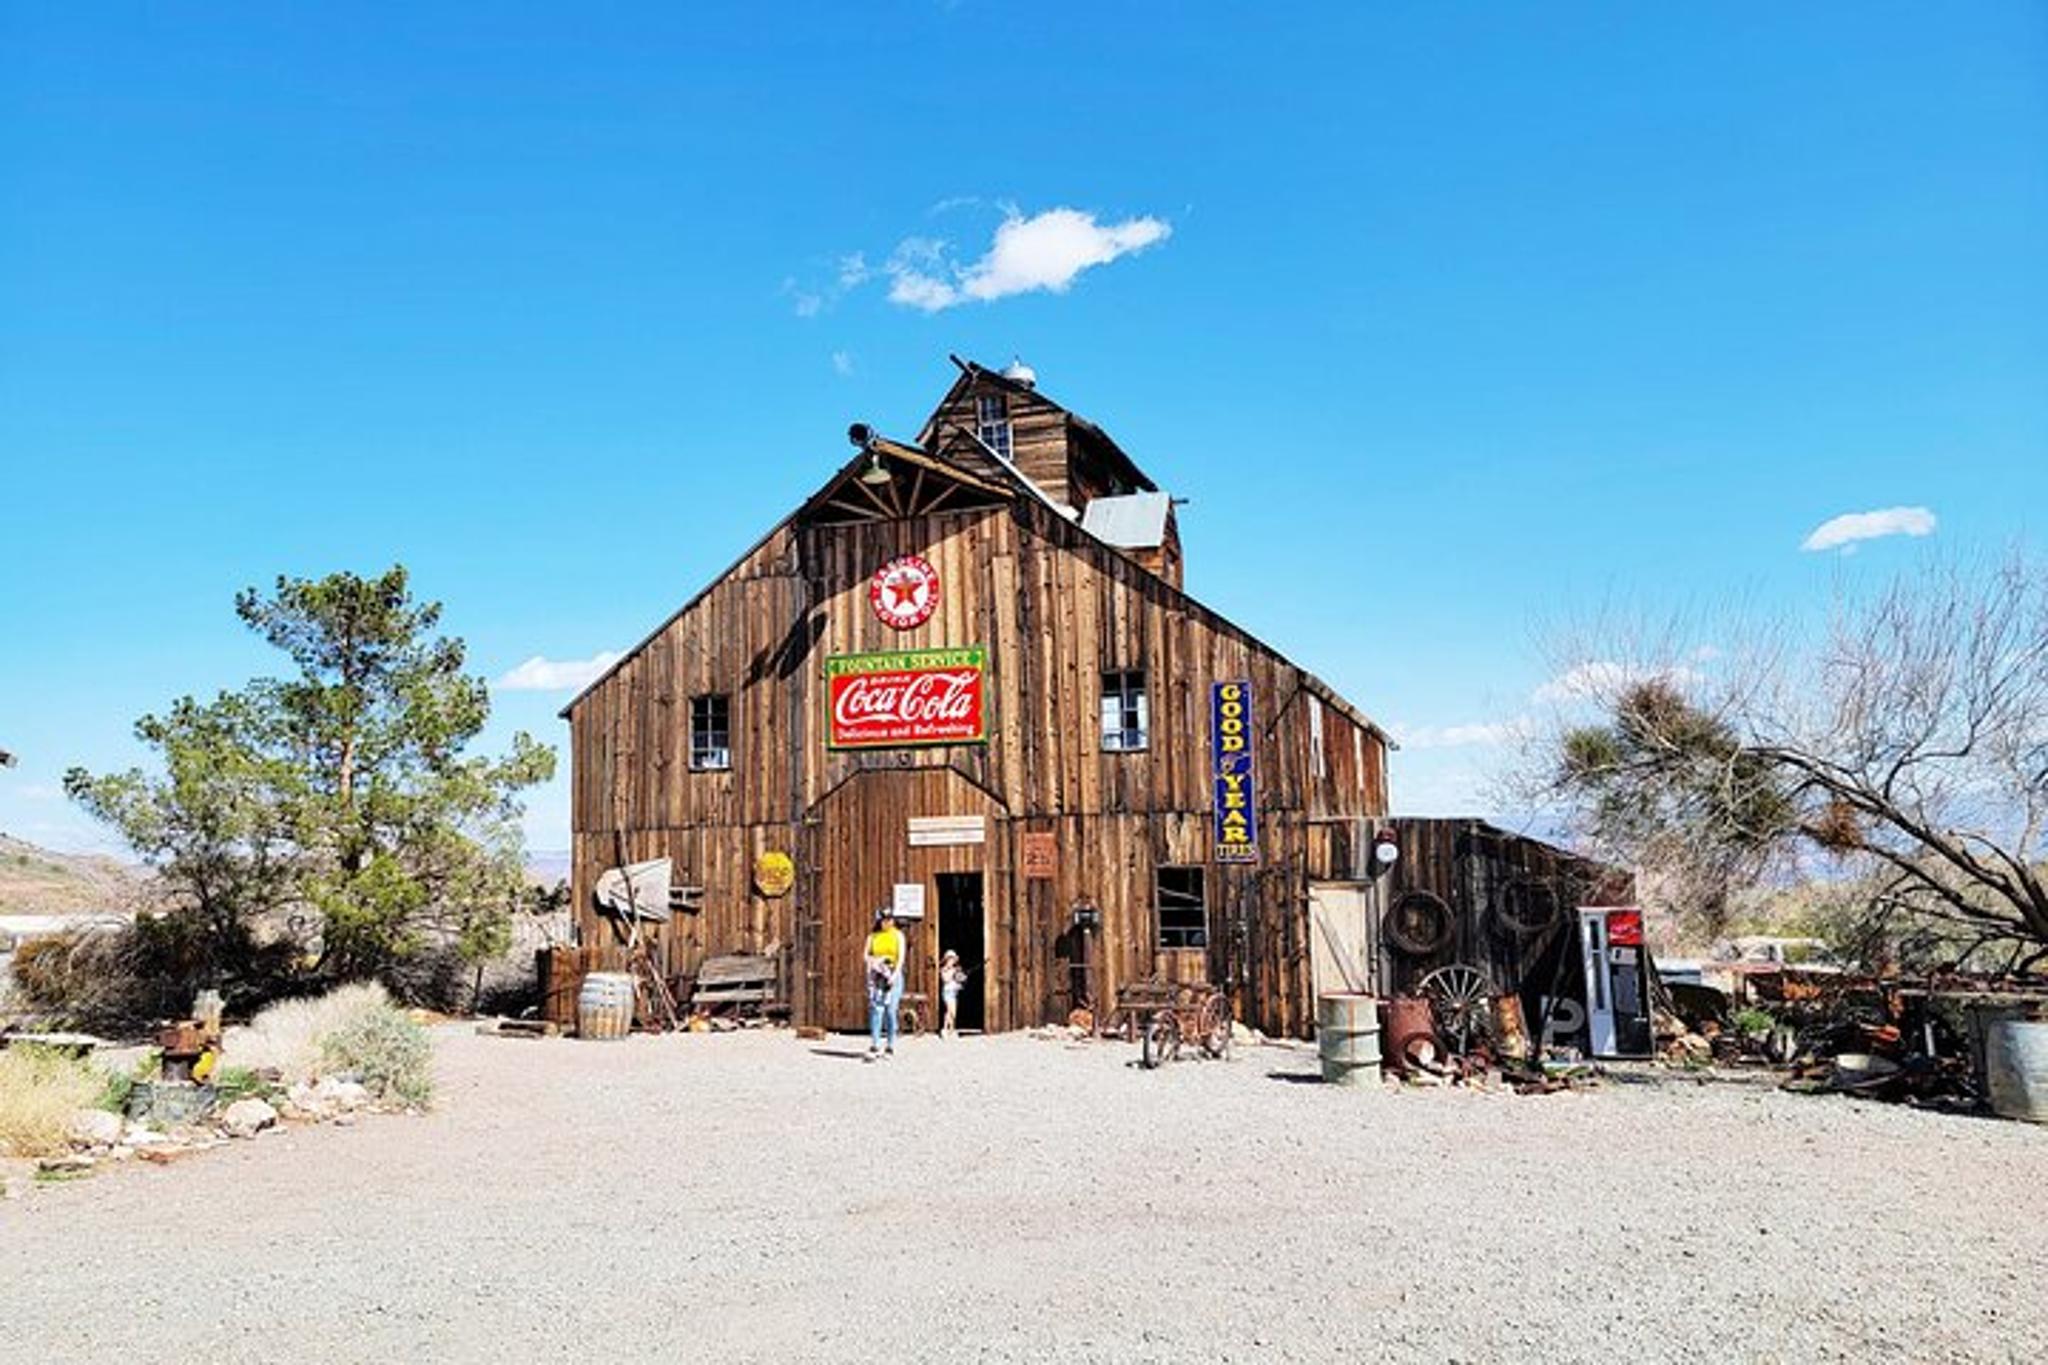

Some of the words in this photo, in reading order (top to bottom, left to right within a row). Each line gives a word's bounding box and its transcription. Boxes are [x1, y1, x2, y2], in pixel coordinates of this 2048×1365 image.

[839, 655, 905, 673] FOUNTAIN
[911, 652, 970, 669] SERVICE
[837, 727, 889, 739] Delicious
[889, 725, 912, 738] and
[914, 722, 975, 737] Refreshing
[1216, 844, 1255, 858] TIRES
